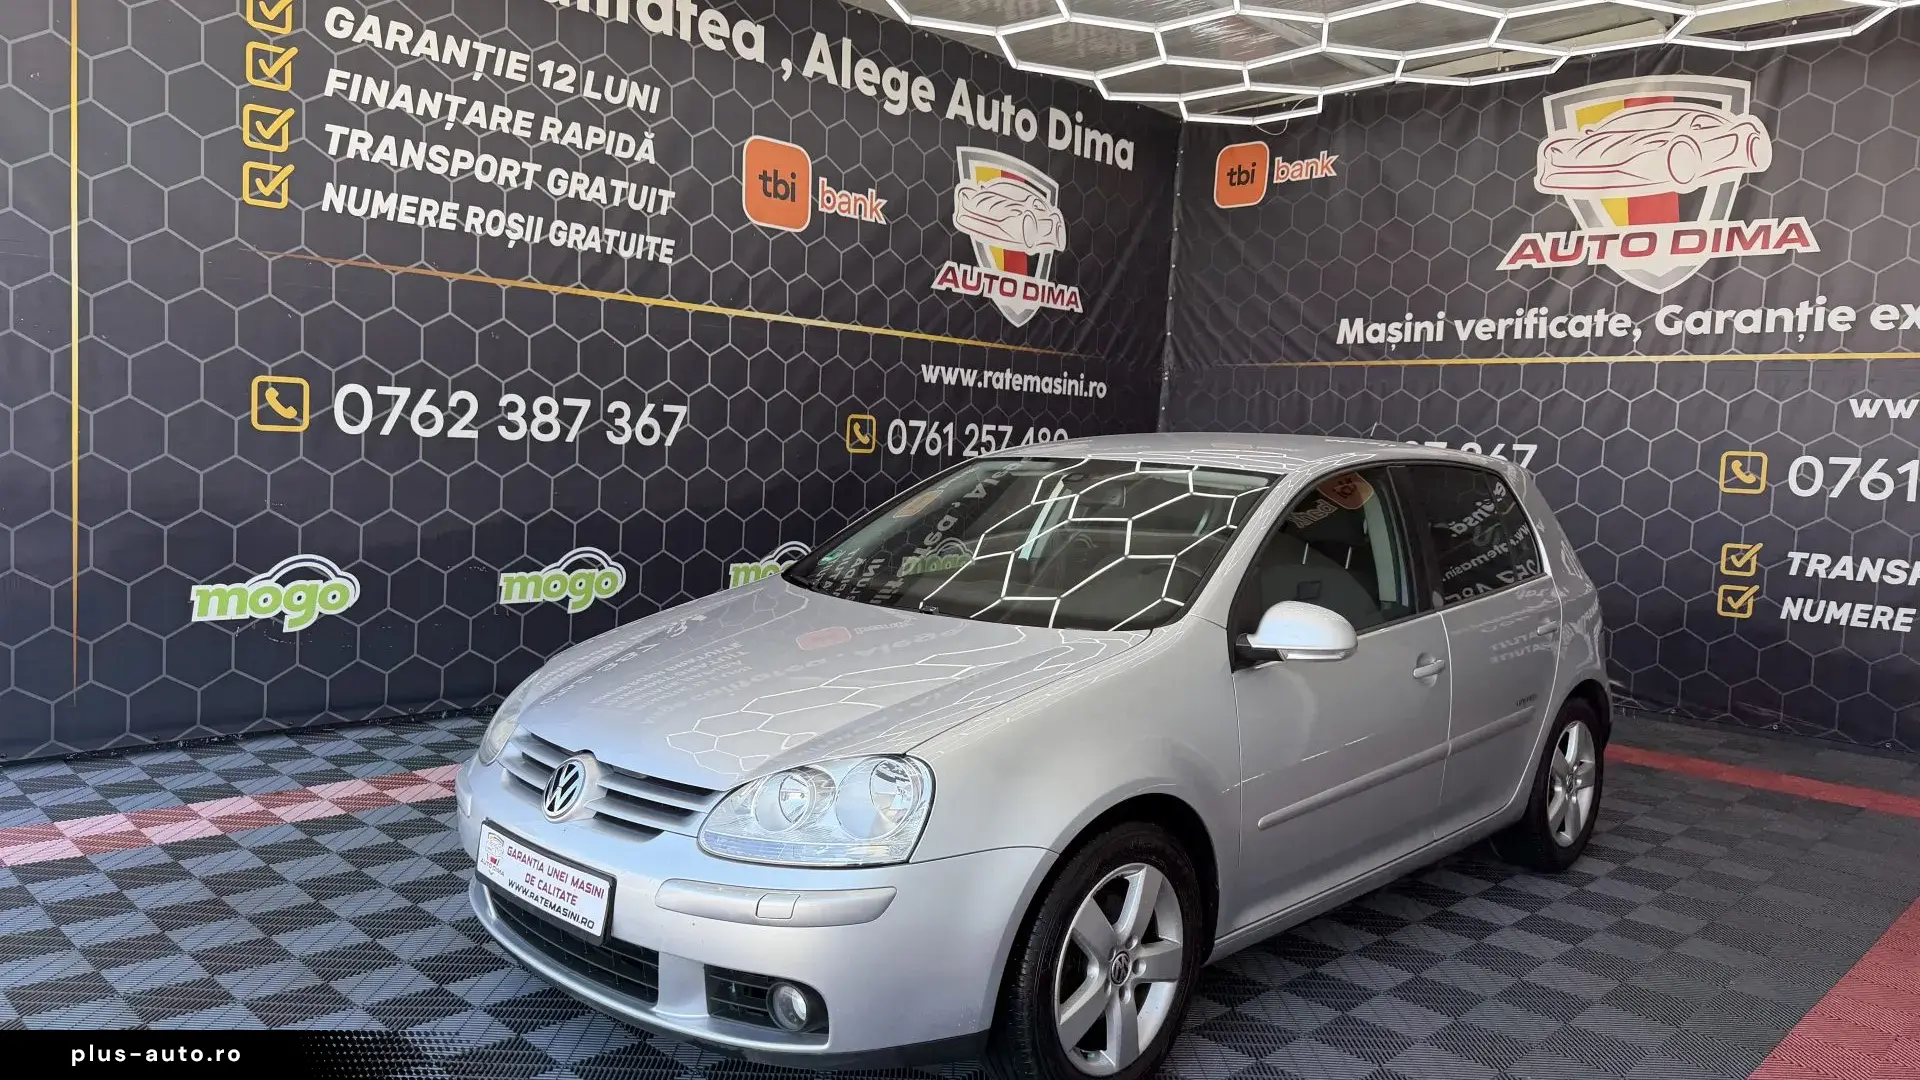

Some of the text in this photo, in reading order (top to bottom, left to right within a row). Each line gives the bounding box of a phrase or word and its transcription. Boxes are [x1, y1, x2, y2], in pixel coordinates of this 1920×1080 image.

[324, 6, 661, 114] GARANȚIE 12 LUNI
[324, 68, 657, 165] FINANȚARE RAPIDĂ
[945, 85, 1040, 143] Auto
[1047, 111, 1136, 171] Dima
[323, 124, 676, 216] TRANSPORT GRATUIT
[1227, 151, 1338, 187] tbi bank
[758, 169, 886, 223] tbi bank
[321, 182, 676, 265] NUMERE ROȘII GRATUITE
[1506, 222, 1811, 265] AUTO DIMA
[937, 264, 1080, 309] AUTO DIMA
[1336, 313, 1446, 352] Mașini
[1454, 305, 1643, 345] verificate,
[1655, 295, 1857, 343] Garanție
[921, 363, 1108, 399] www.ratemasini.ro
[333, 383, 688, 447] 0762 387 367
[887, 418, 955, 457] 0761
[962, 422, 1014, 457] 257
[1788, 455, 1920, 503] 0761
[194, 581, 352, 630] mogo
[502, 566, 621, 611] mogo
[1779, 596, 1917, 633] NUMERE
[506, 845, 605, 900] GARANTIA UNEI MASINI
[524, 872, 579, 906] DE CALITATE
[508, 878, 596, 930] WWW.RATEMASINI.RO
